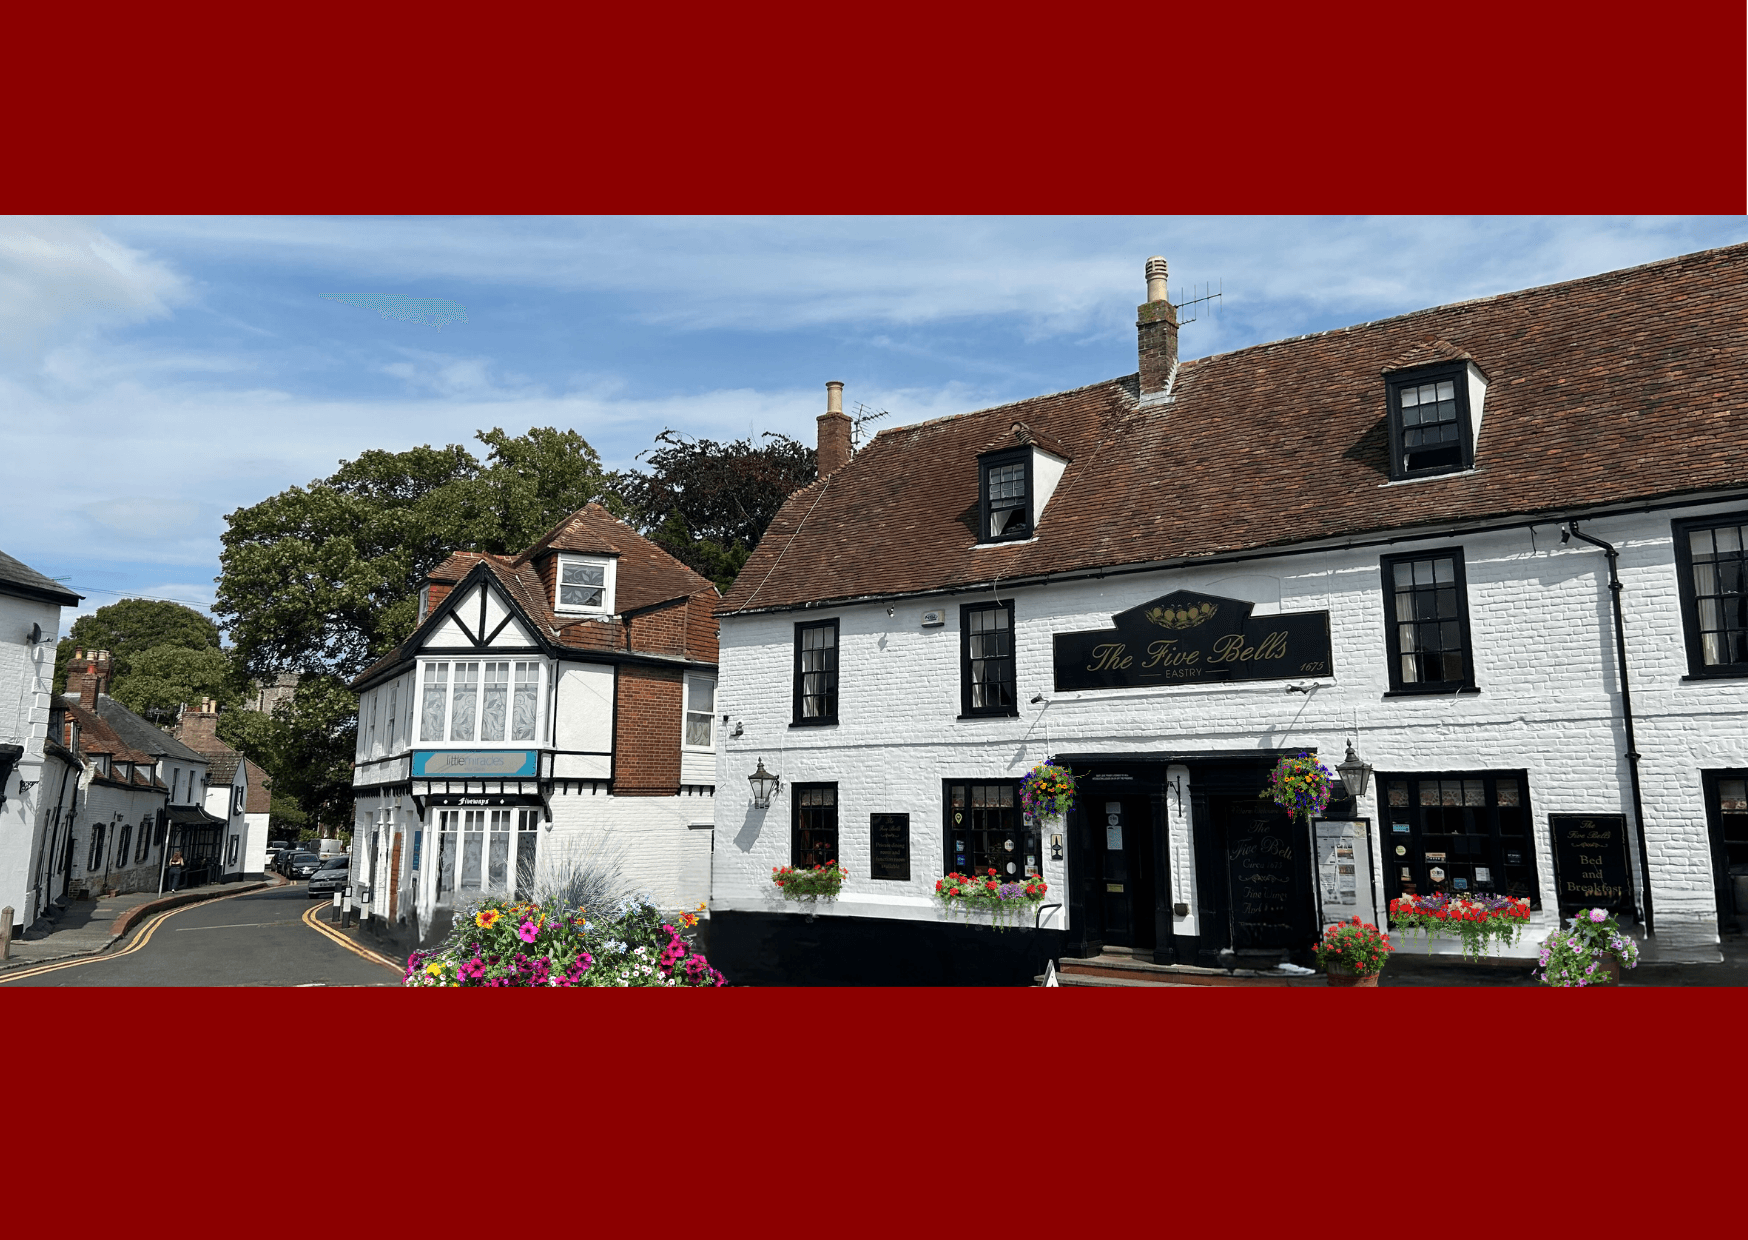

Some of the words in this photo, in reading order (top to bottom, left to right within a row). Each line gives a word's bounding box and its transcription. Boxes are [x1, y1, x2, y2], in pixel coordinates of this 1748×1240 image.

[1086, 643, 1134, 672] The
[1141, 639, 1200, 668] Five
[1207, 631, 1288, 663] Bells
[1300, 661, 1324, 671] 1675
[1165, 667, 1203, 679] EASTRY
[458, 797, 489, 806] Fiveways
[1247, 819, 1271, 834] The
[1580, 820, 1596, 828] The
[1567, 830, 1585, 839] Five
[1587, 830, 1611, 839] Bells
[1229, 836, 1258, 861] Five
[1242, 858, 1265, 869] Circa
[1579, 854, 1603, 865] Bed
[1582, 869, 1604, 879] and
[1243, 886, 1262, 899] Fine
[1567, 882, 1622, 892] Breakfast
